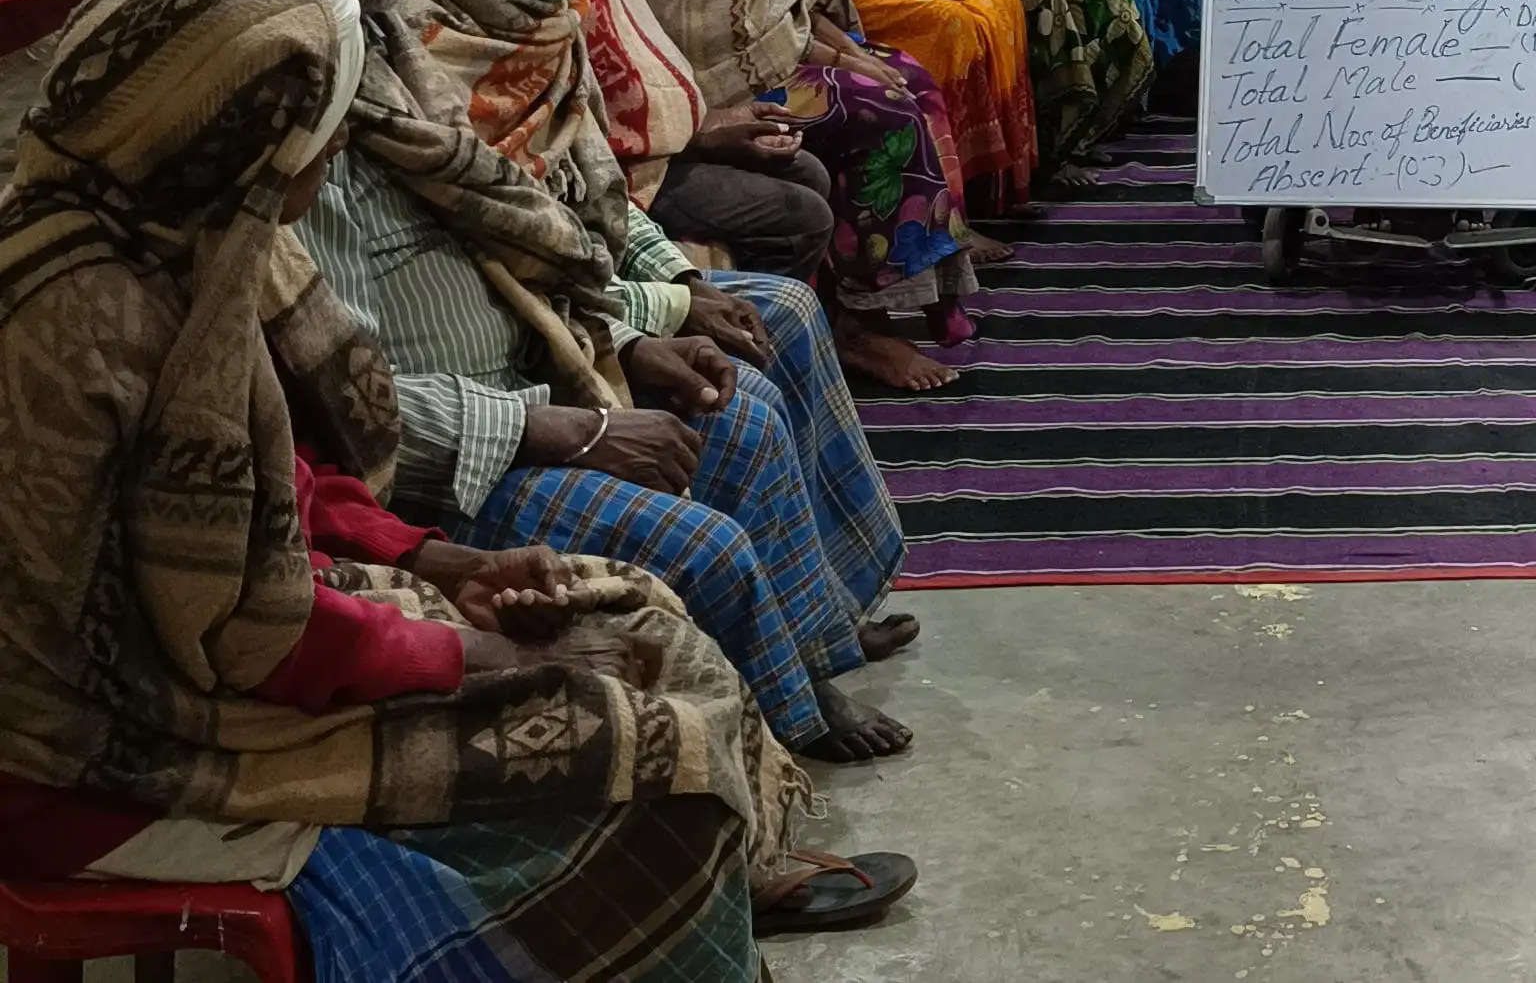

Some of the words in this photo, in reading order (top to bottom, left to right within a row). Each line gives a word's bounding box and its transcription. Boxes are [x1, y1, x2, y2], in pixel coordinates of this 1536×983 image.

[1223, 15, 1321, 64] Total
[1327, 15, 1461, 60] Female
[1221, 65, 1307, 110] Total
[1323, 61, 1417, 100] Male
[1218, 113, 1303, 164] Total
[1381, 108, 1414, 160] of
[1414, 105, 1533, 145] Beneficiaries
